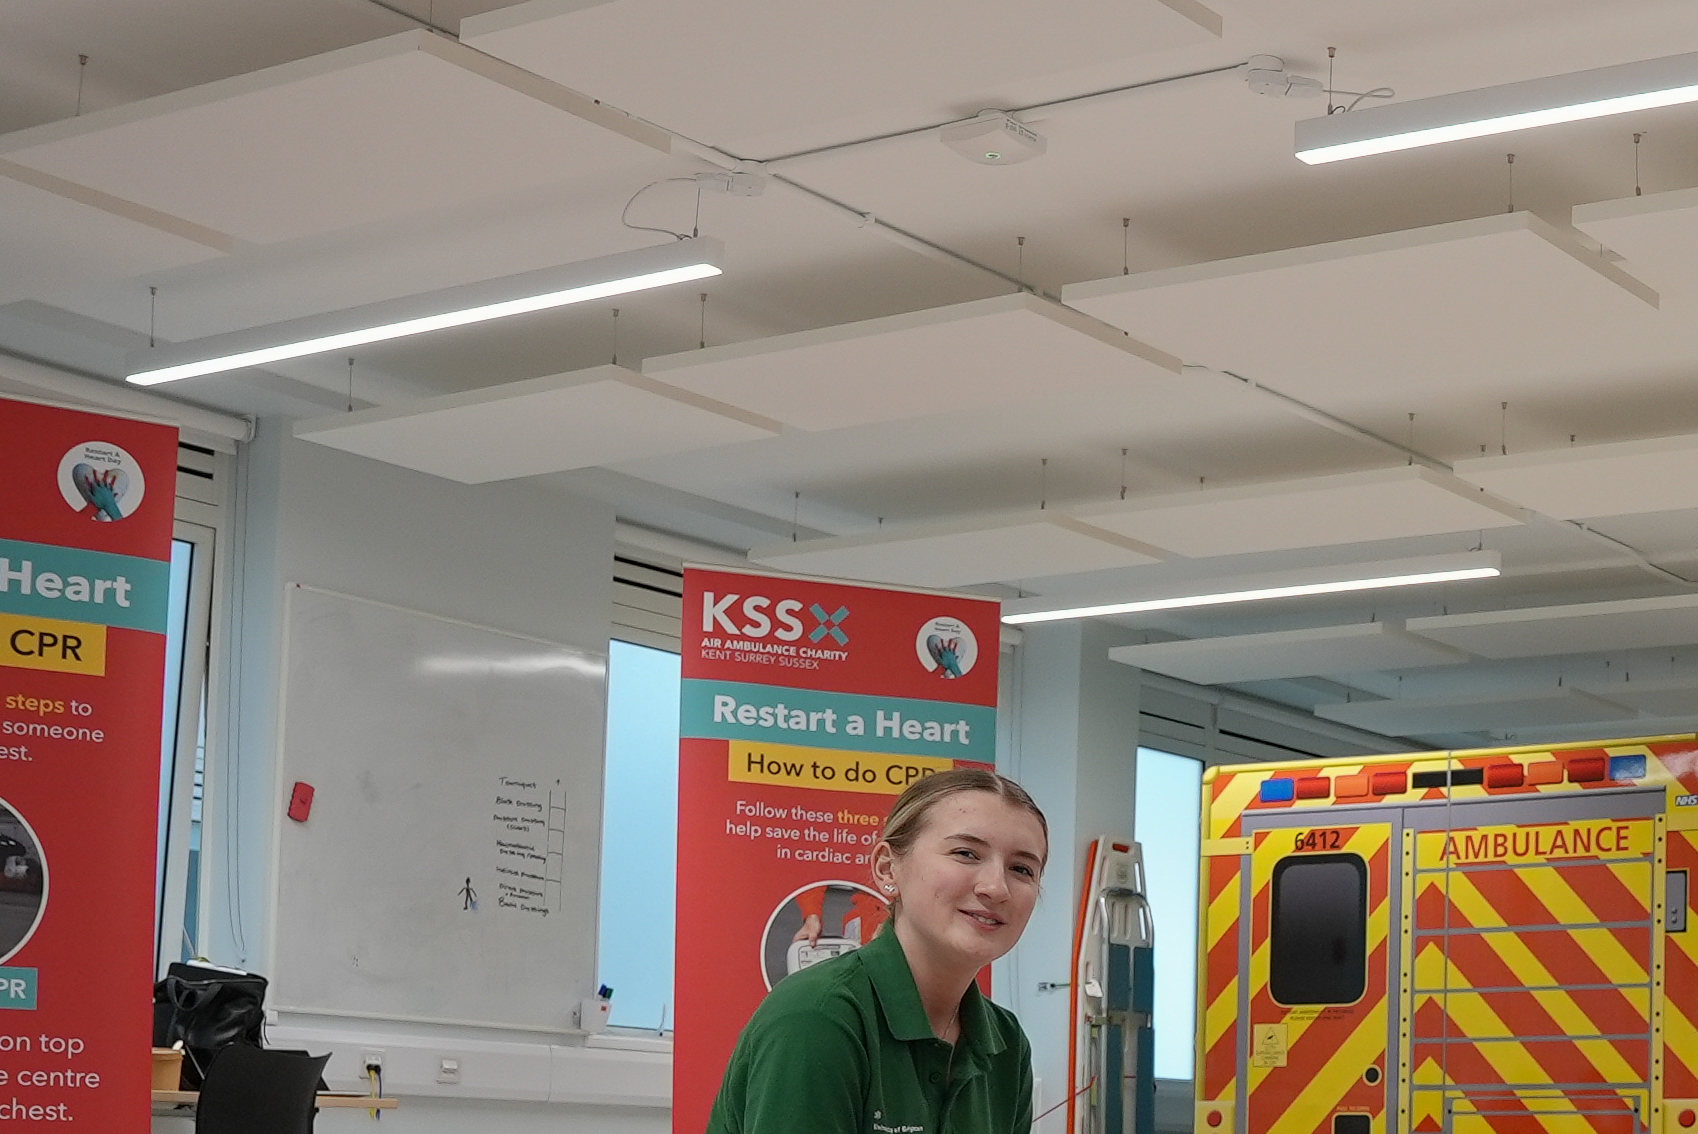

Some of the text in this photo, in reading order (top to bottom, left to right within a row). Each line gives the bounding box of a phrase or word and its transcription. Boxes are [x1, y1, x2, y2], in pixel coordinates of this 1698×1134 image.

[0, 557, 131, 608] Heart
[702, 591, 804, 642] KSS
[10, 629, 83, 662] CPR
[701, 637, 849, 662] AIR AMBULANCE CHARITY
[701, 649, 820, 670] KENT SURREY SUSSEX
[5, 694, 93, 717] steps to
[2, 720, 105, 743] someone
[713, 694, 970, 745] Restart a Heart
[747, 752, 804, 778] How
[811, 761, 836, 780] to
[844, 761, 877, 783] do
[1675, 795, 1698, 806] NHS
[736, 801, 788, 819] Follow
[791, 805, 834, 823] these
[837, 809, 879, 826] three
[726, 819, 879, 845] help save the life of
[1295, 830, 1340, 851] 6412
[1439, 826, 1630, 861] AMBULANCE
[776, 844, 791, 859] in
[794, 847, 852, 865] cardiac
[0, 1033, 85, 1059] on top
[17, 1069, 100, 1088] centre
[0, 1097, 74, 1122] chest.
